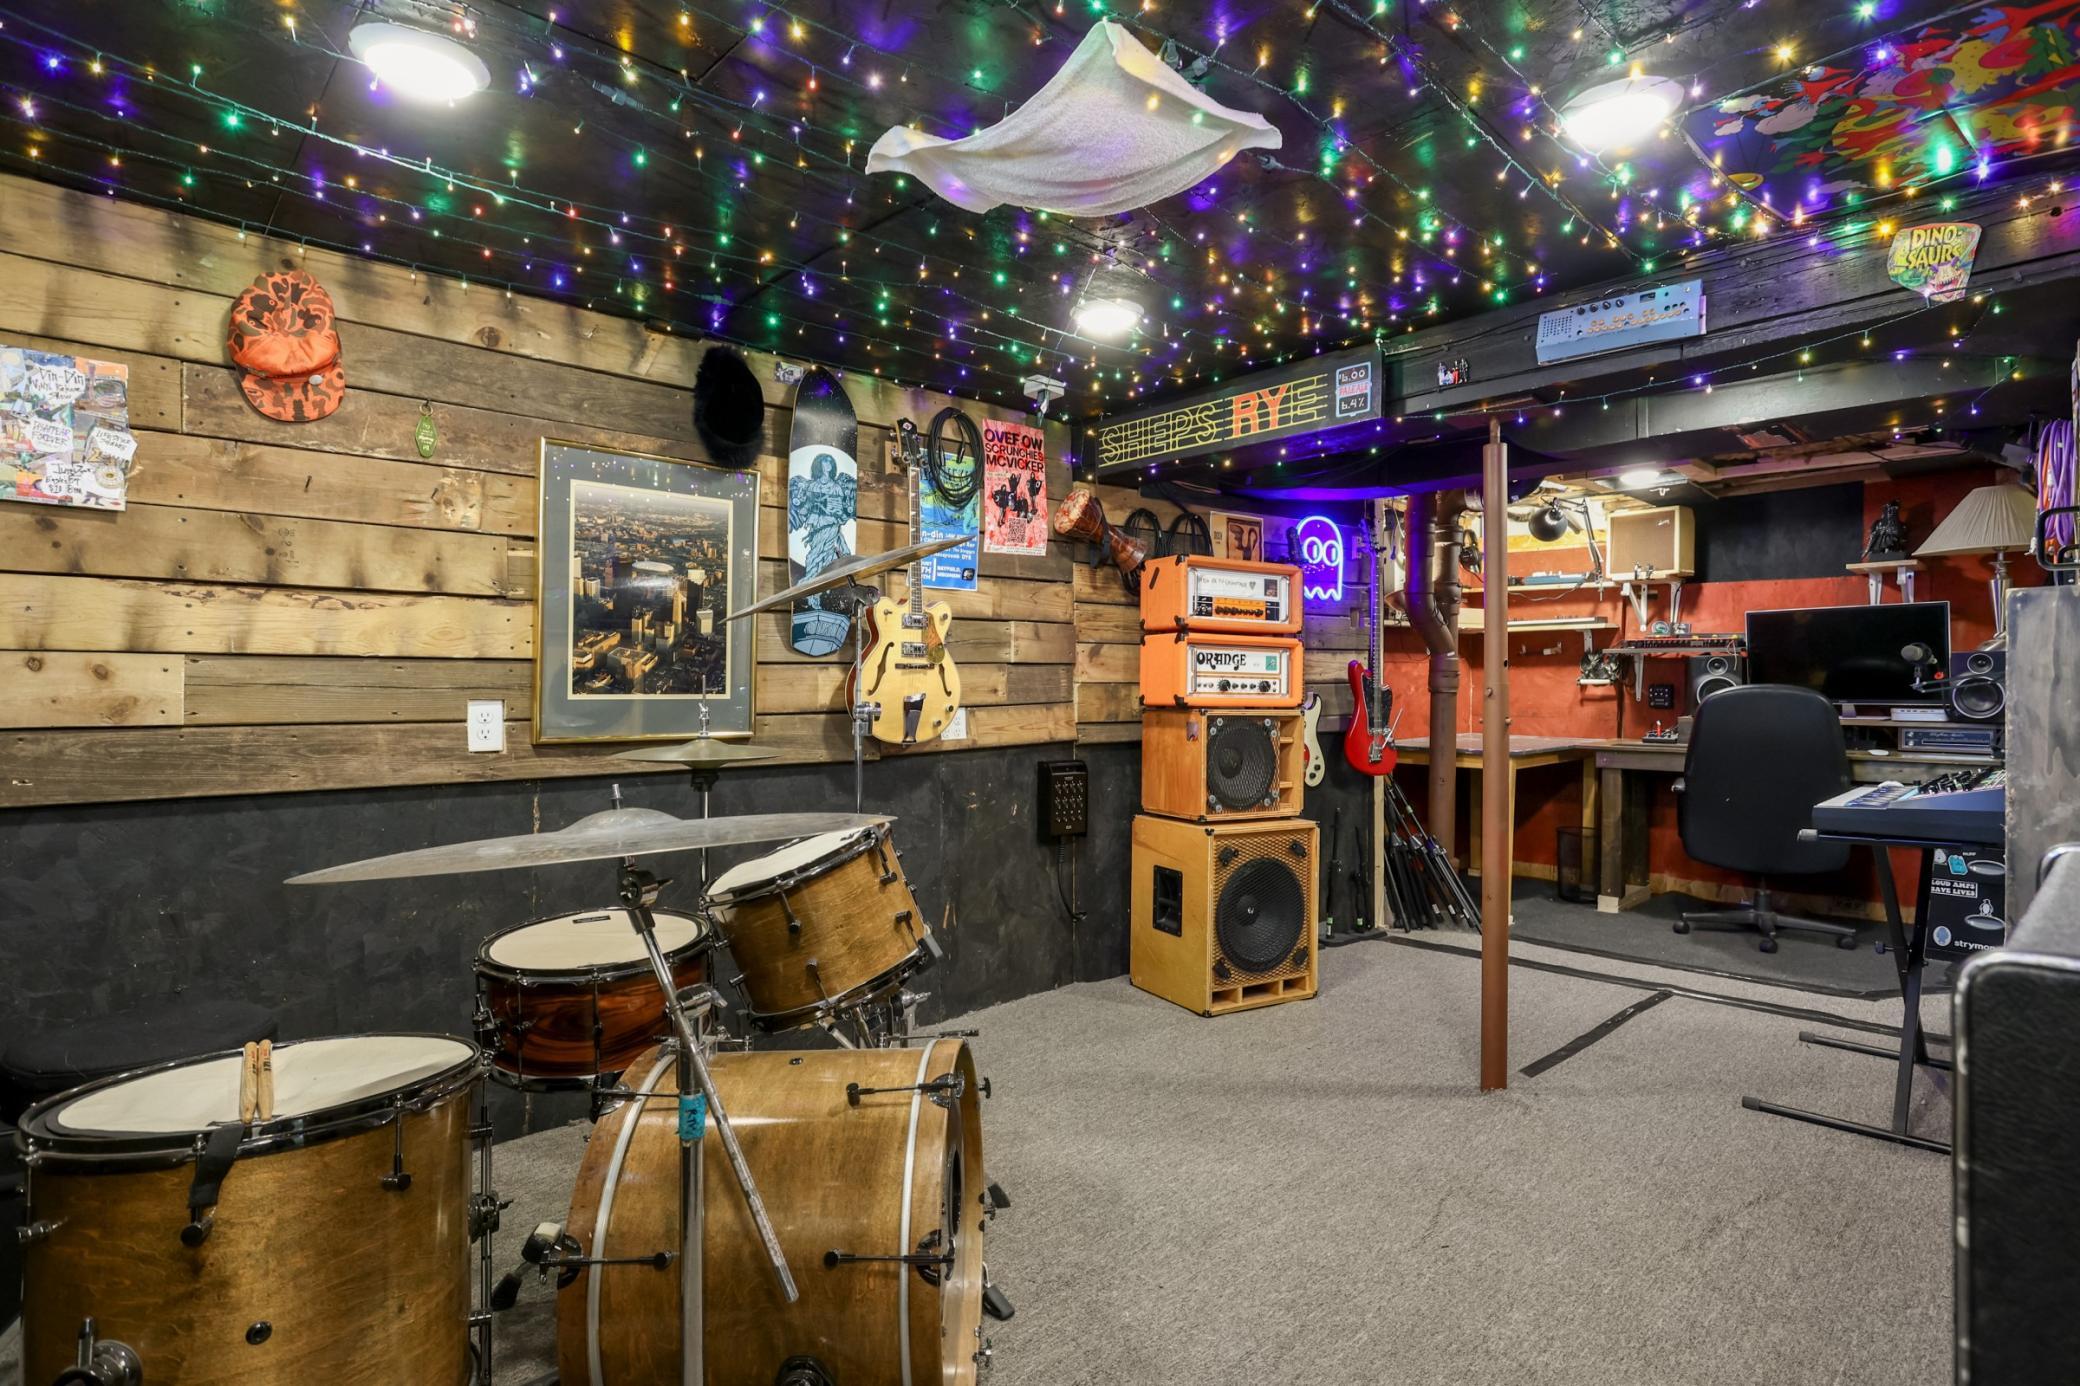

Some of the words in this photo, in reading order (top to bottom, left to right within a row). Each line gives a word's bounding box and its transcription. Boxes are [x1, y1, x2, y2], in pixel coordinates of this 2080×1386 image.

[1907, 244, 1962, 270] SAURS
[1102, 402, 1217, 465] SHEPS
[986, 454, 1044, 473] MCVICKER
[1196, 651, 1247, 671] ORANGE
[1953, 881, 1976, 890] AMPS
[1953, 888, 1976, 897] LIVES
